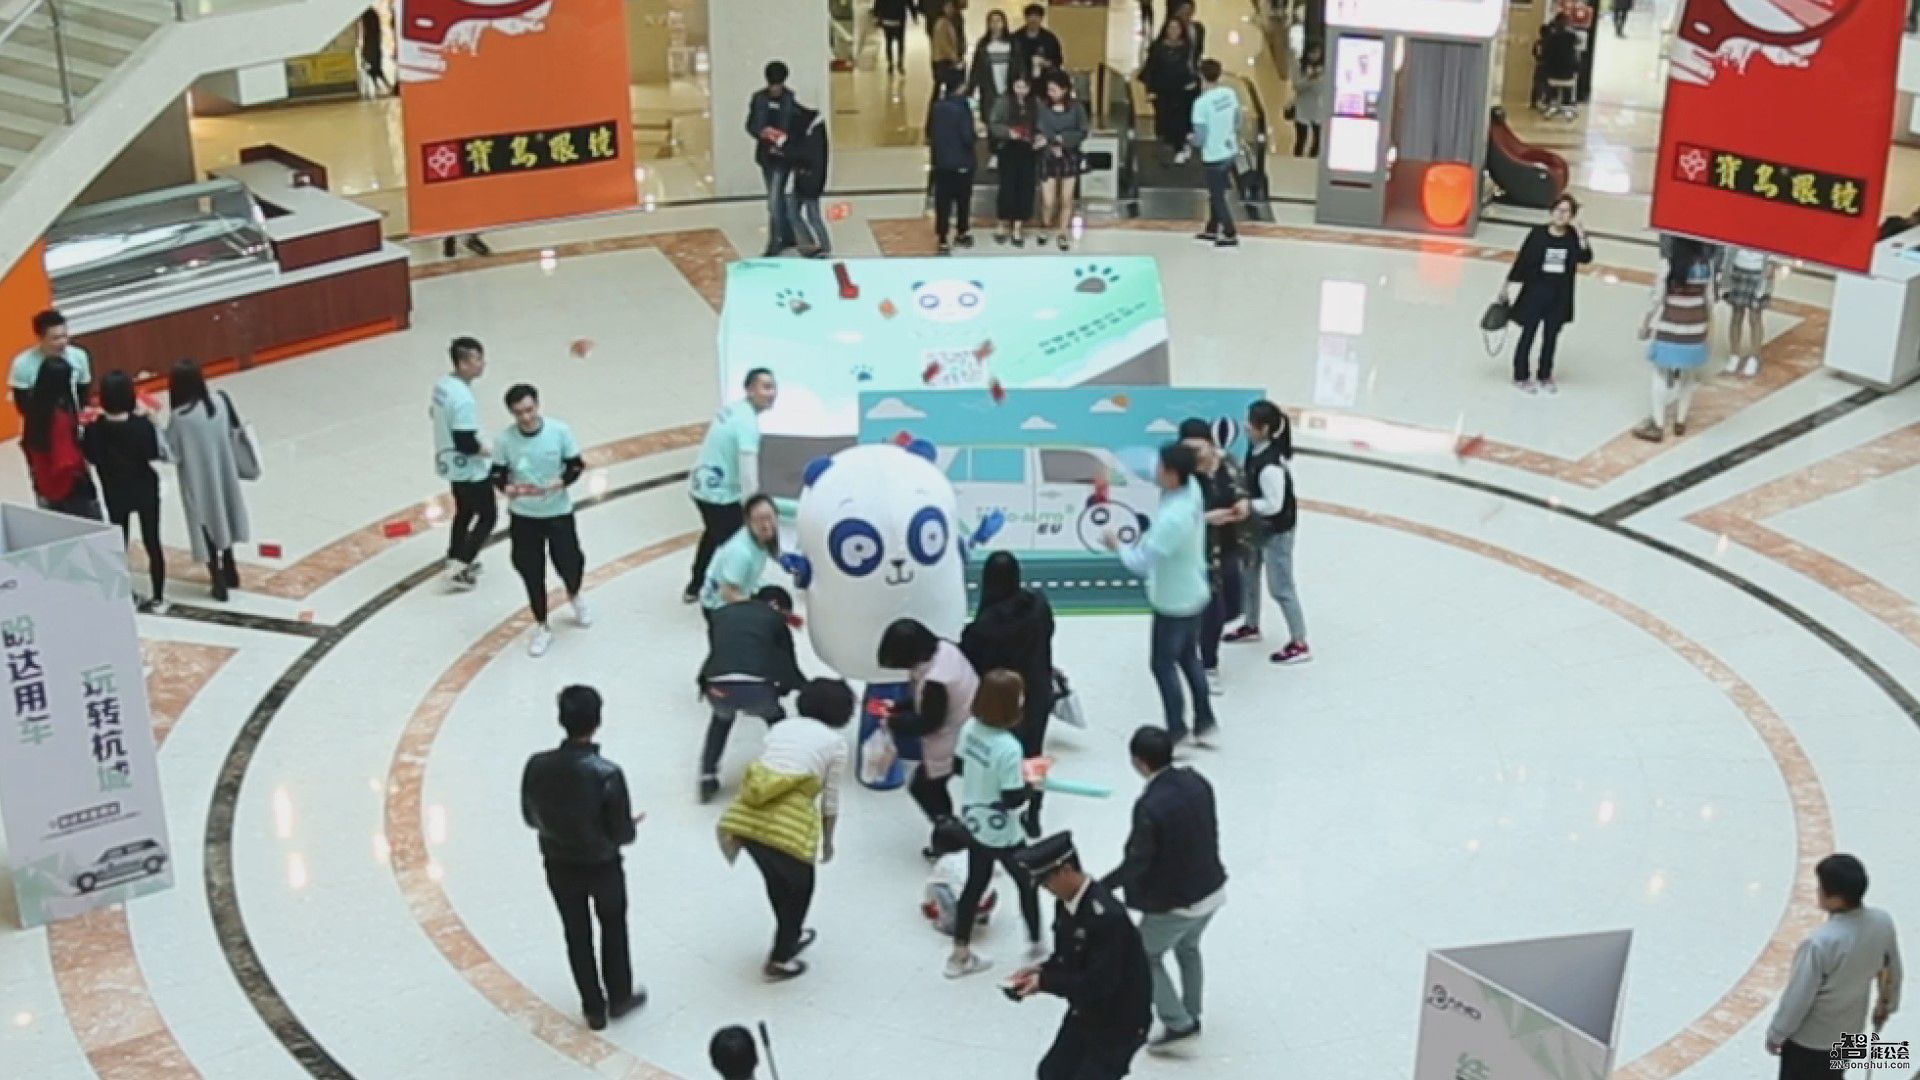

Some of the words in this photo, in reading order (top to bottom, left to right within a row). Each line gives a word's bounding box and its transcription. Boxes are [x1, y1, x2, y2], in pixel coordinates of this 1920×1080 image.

[2, 614, 53, 745] 盼达用车
[81, 664, 131, 792] 玩转杭城
